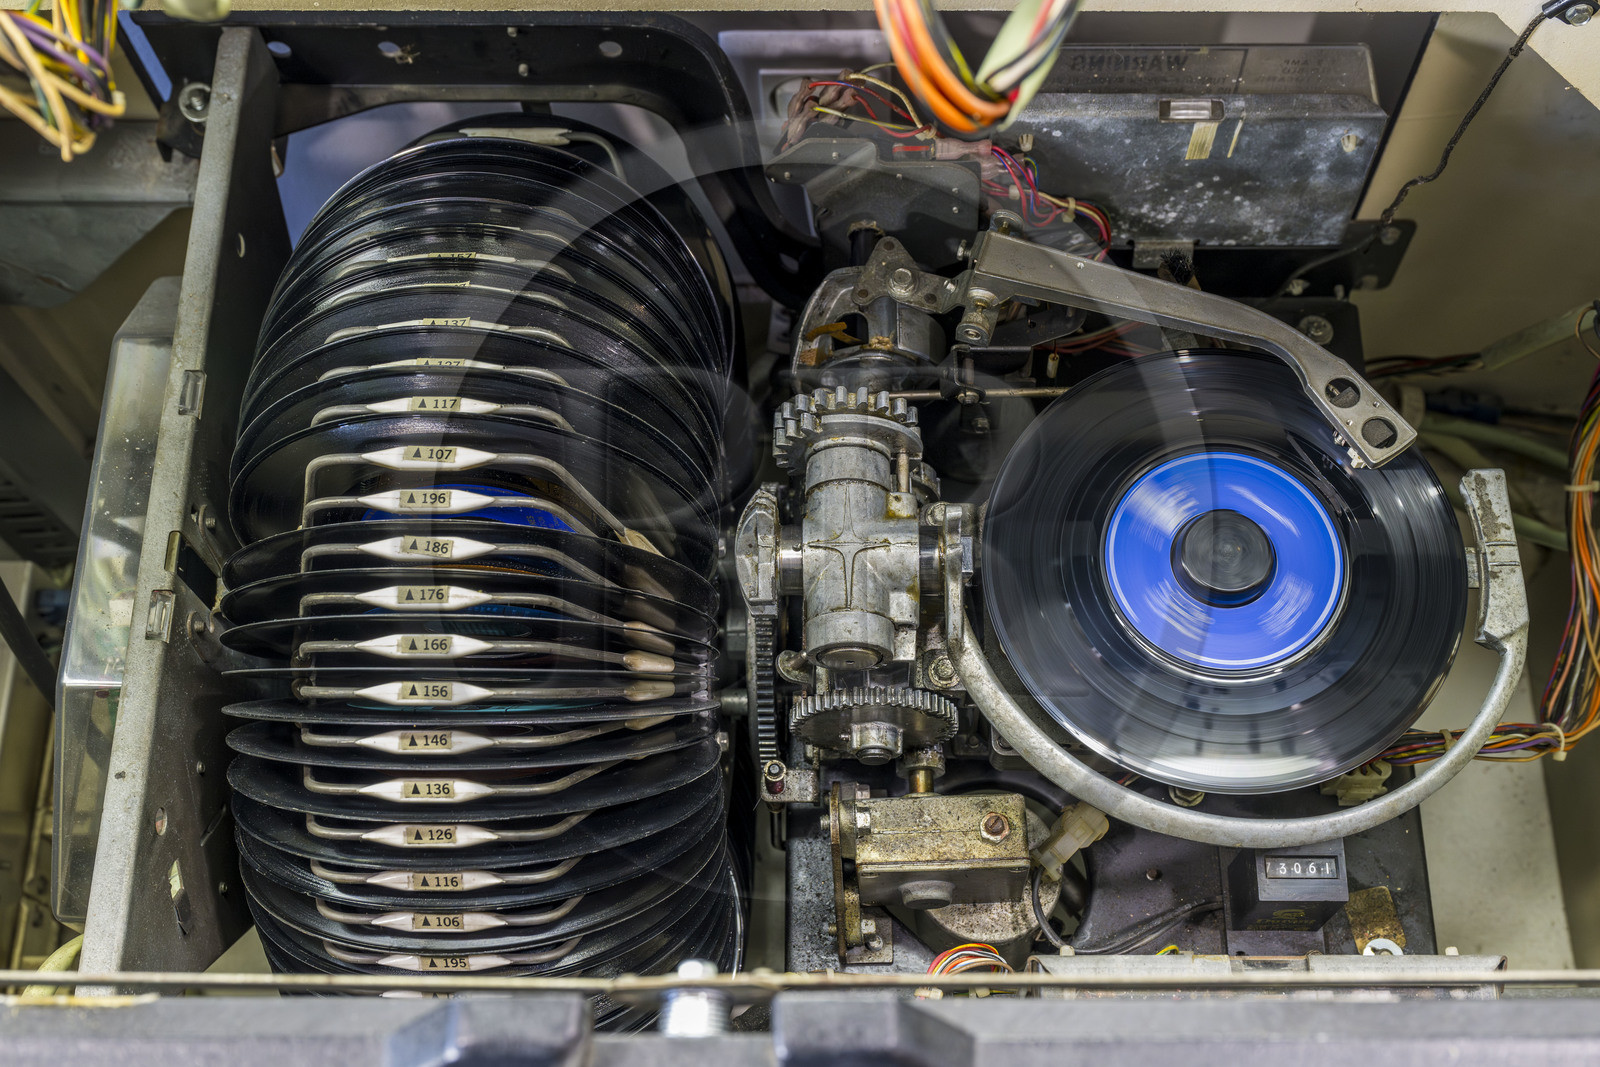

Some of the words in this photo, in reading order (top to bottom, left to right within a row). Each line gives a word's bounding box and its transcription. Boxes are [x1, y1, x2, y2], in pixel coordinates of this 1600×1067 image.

[444, 319, 467, 327] 137
[432, 398, 458, 409] 117
[427, 448, 453, 460] 107
[421, 492, 447, 504] 196
[424, 541, 449, 554] 186
[419, 588, 445, 601] 176
[423, 638, 448, 650] 166
[423, 685, 448, 698] 156
[422, 734, 448, 746] 146
[426, 783, 451, 795] 136
[428, 829, 453, 841] 126
[434, 876, 459, 887] 116
[436, 916, 460, 927] 106
[444, 958, 467, 968] 195
